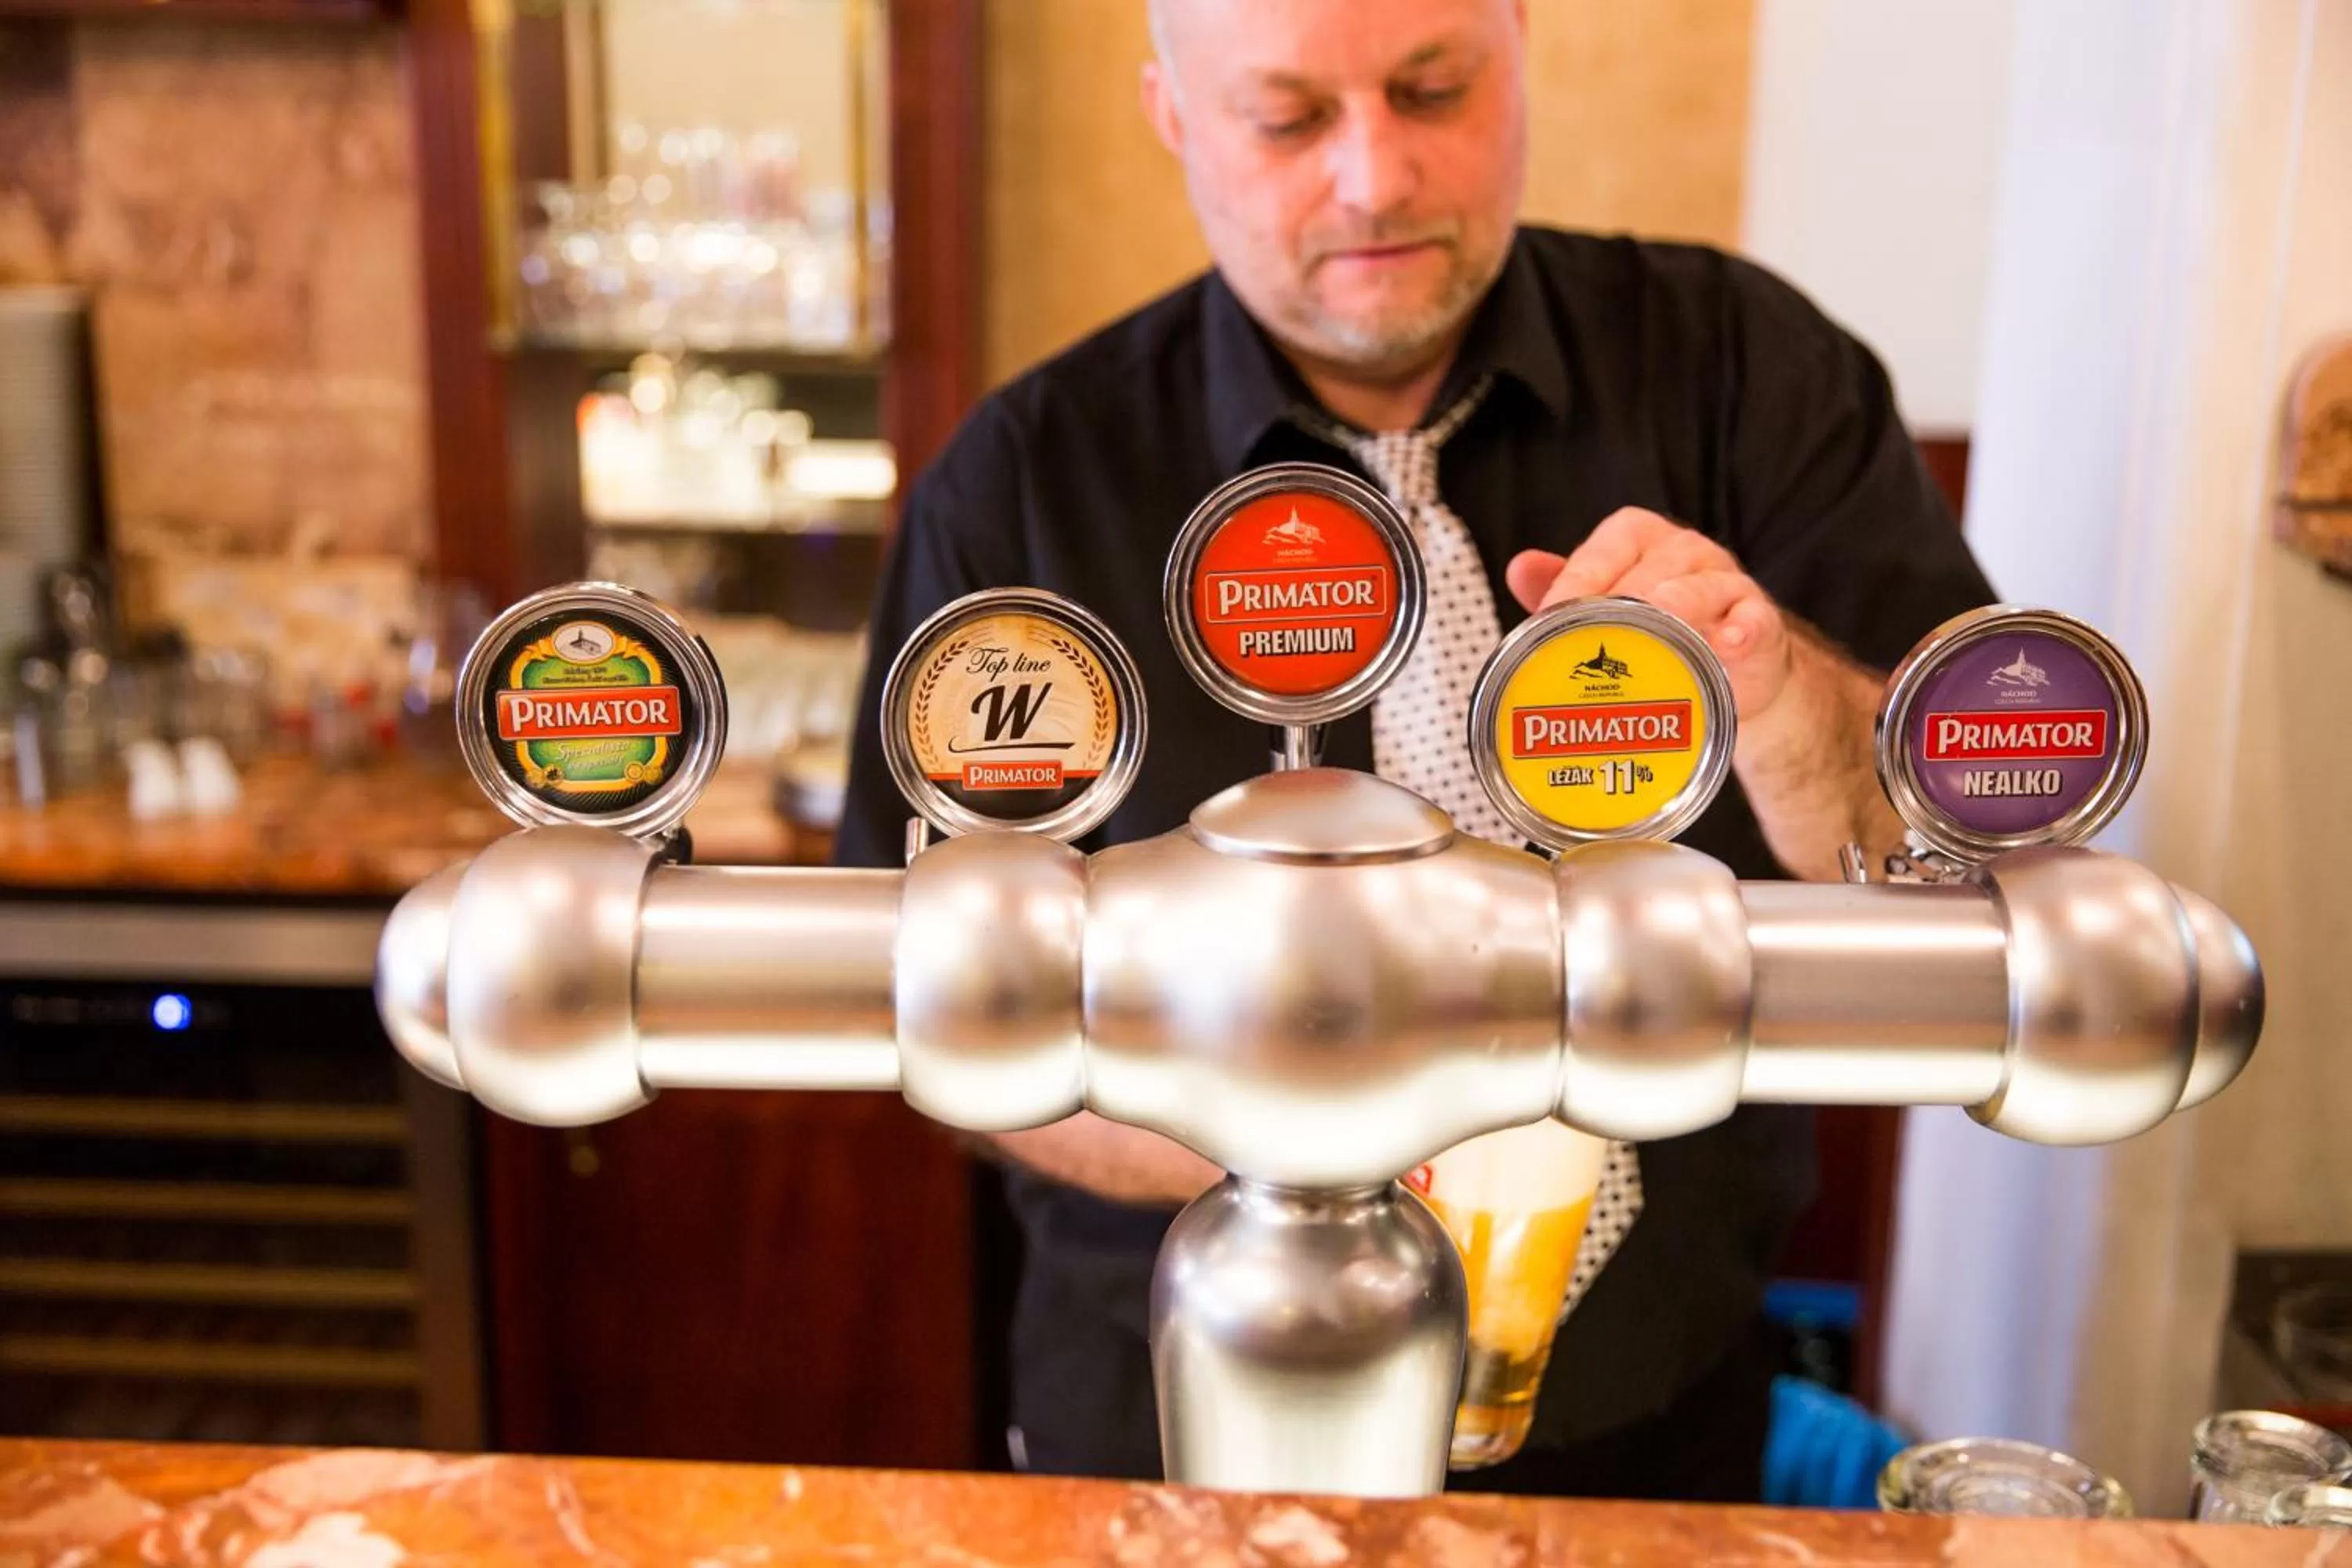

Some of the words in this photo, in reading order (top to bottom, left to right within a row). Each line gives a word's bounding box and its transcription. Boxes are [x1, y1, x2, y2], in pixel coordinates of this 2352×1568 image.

[1218, 579, 1374, 615] PRIMÁTOR
[1240, 627, 1354, 657] PREMIUM
[966, 648, 1008, 681] Top
[1013, 649, 1051, 673] line
[510, 697, 669, 732] PRIMÁTOR
[971, 682, 1052, 741] W
[1524, 714, 1680, 750] PRIMÁTOR
[1937, 717, 2093, 753] PRIMÁTOR
[1964, 768, 2063, 797] NEALKO
